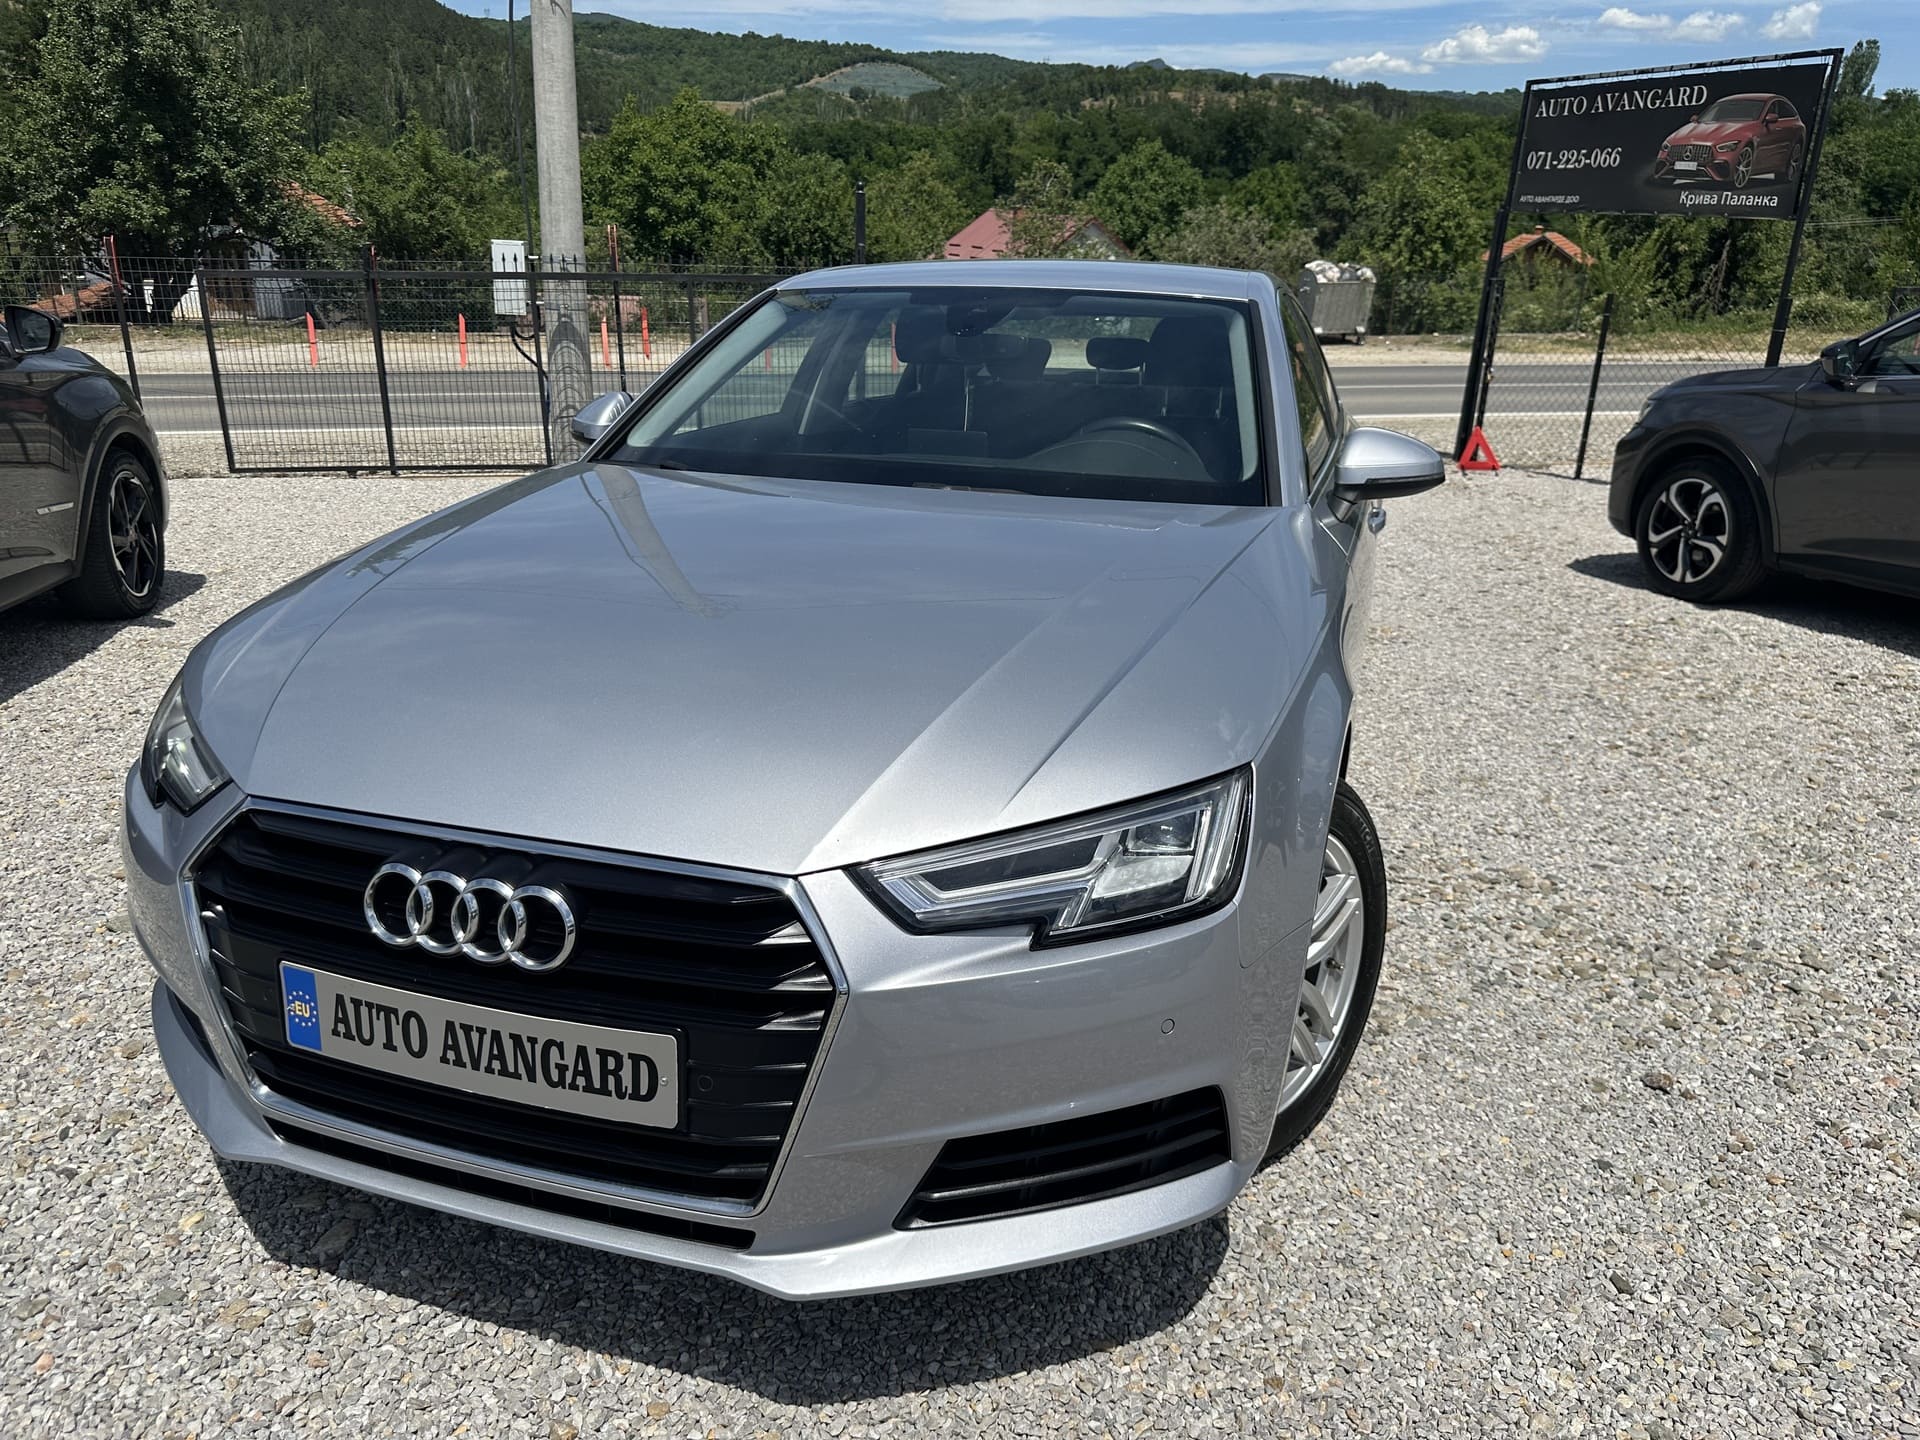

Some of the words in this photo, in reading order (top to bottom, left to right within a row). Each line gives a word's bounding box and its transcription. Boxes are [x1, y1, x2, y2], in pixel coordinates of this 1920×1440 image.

[1535, 96, 1587, 118] AUTO
[1591, 84, 1708, 113] AVANGARD
[1526, 147, 1622, 170] 071-225-066
[1679, 190, 1718, 208] Крива
[1720, 191, 1779, 207] Паланка
[294, 1000, 311, 1018] EU
[331, 993, 428, 1059] AUTO
[439, 1019, 660, 1103] AVANGARD
